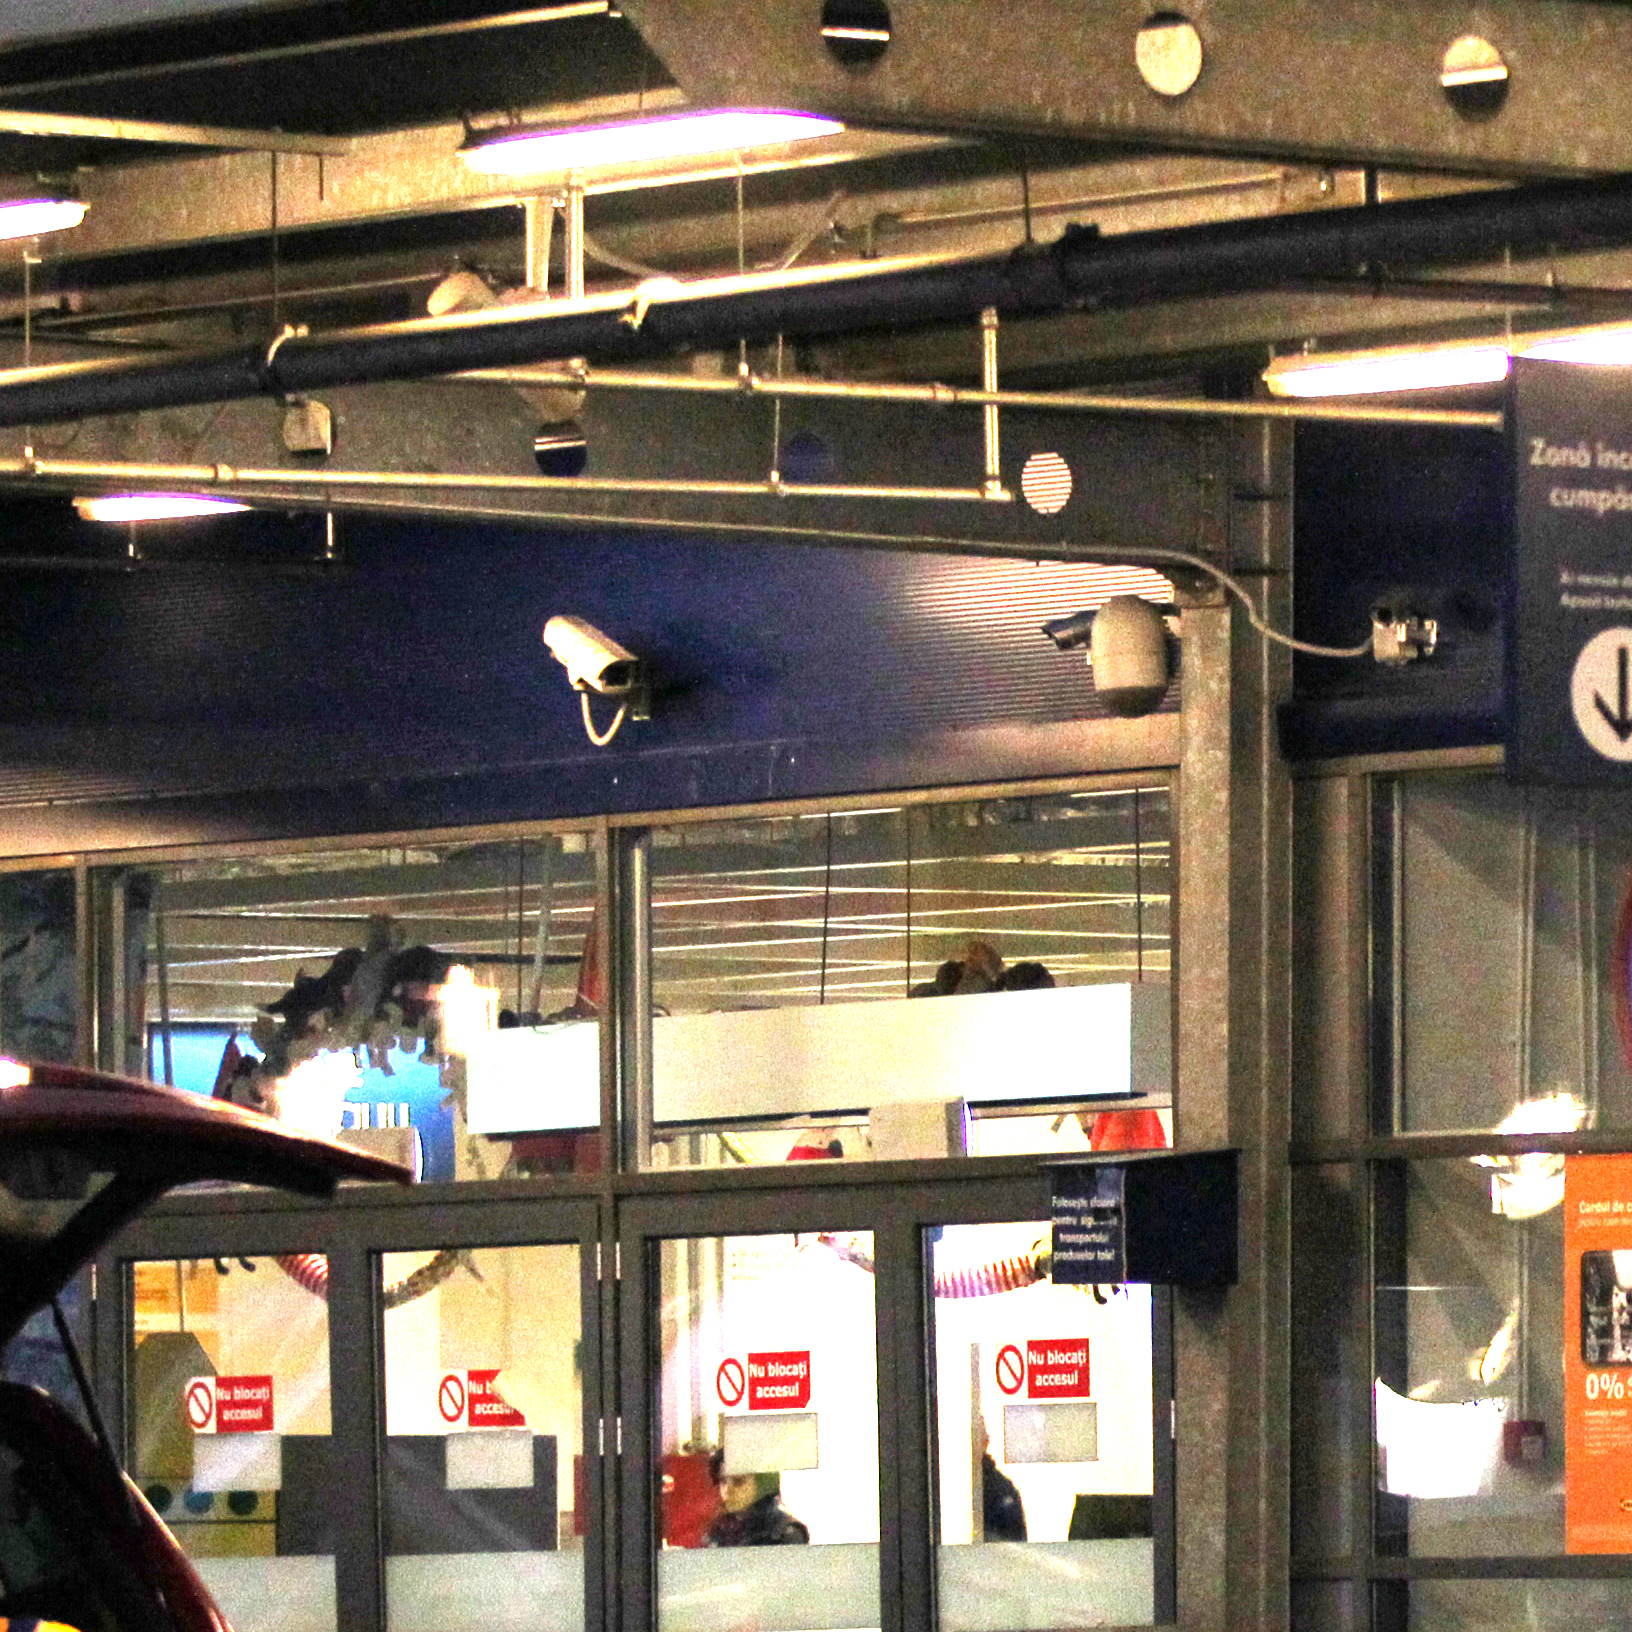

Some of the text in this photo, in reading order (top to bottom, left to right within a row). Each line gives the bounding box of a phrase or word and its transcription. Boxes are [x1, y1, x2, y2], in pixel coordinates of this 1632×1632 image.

[1612, 1200, 1624, 1213] de
[1028, 1351, 1044, 1365] Nu
[750, 1363, 766, 1378] Nu
[1035, 1370, 1078, 1386] accesul
[216, 1387, 232, 1400] Nu
[467, 1379, 483, 1394] Nu
[756, 1382, 799, 1398] accesul
[1586, 1373, 1625, 1400] 0%
[223, 1405, 263, 1420] accesul
